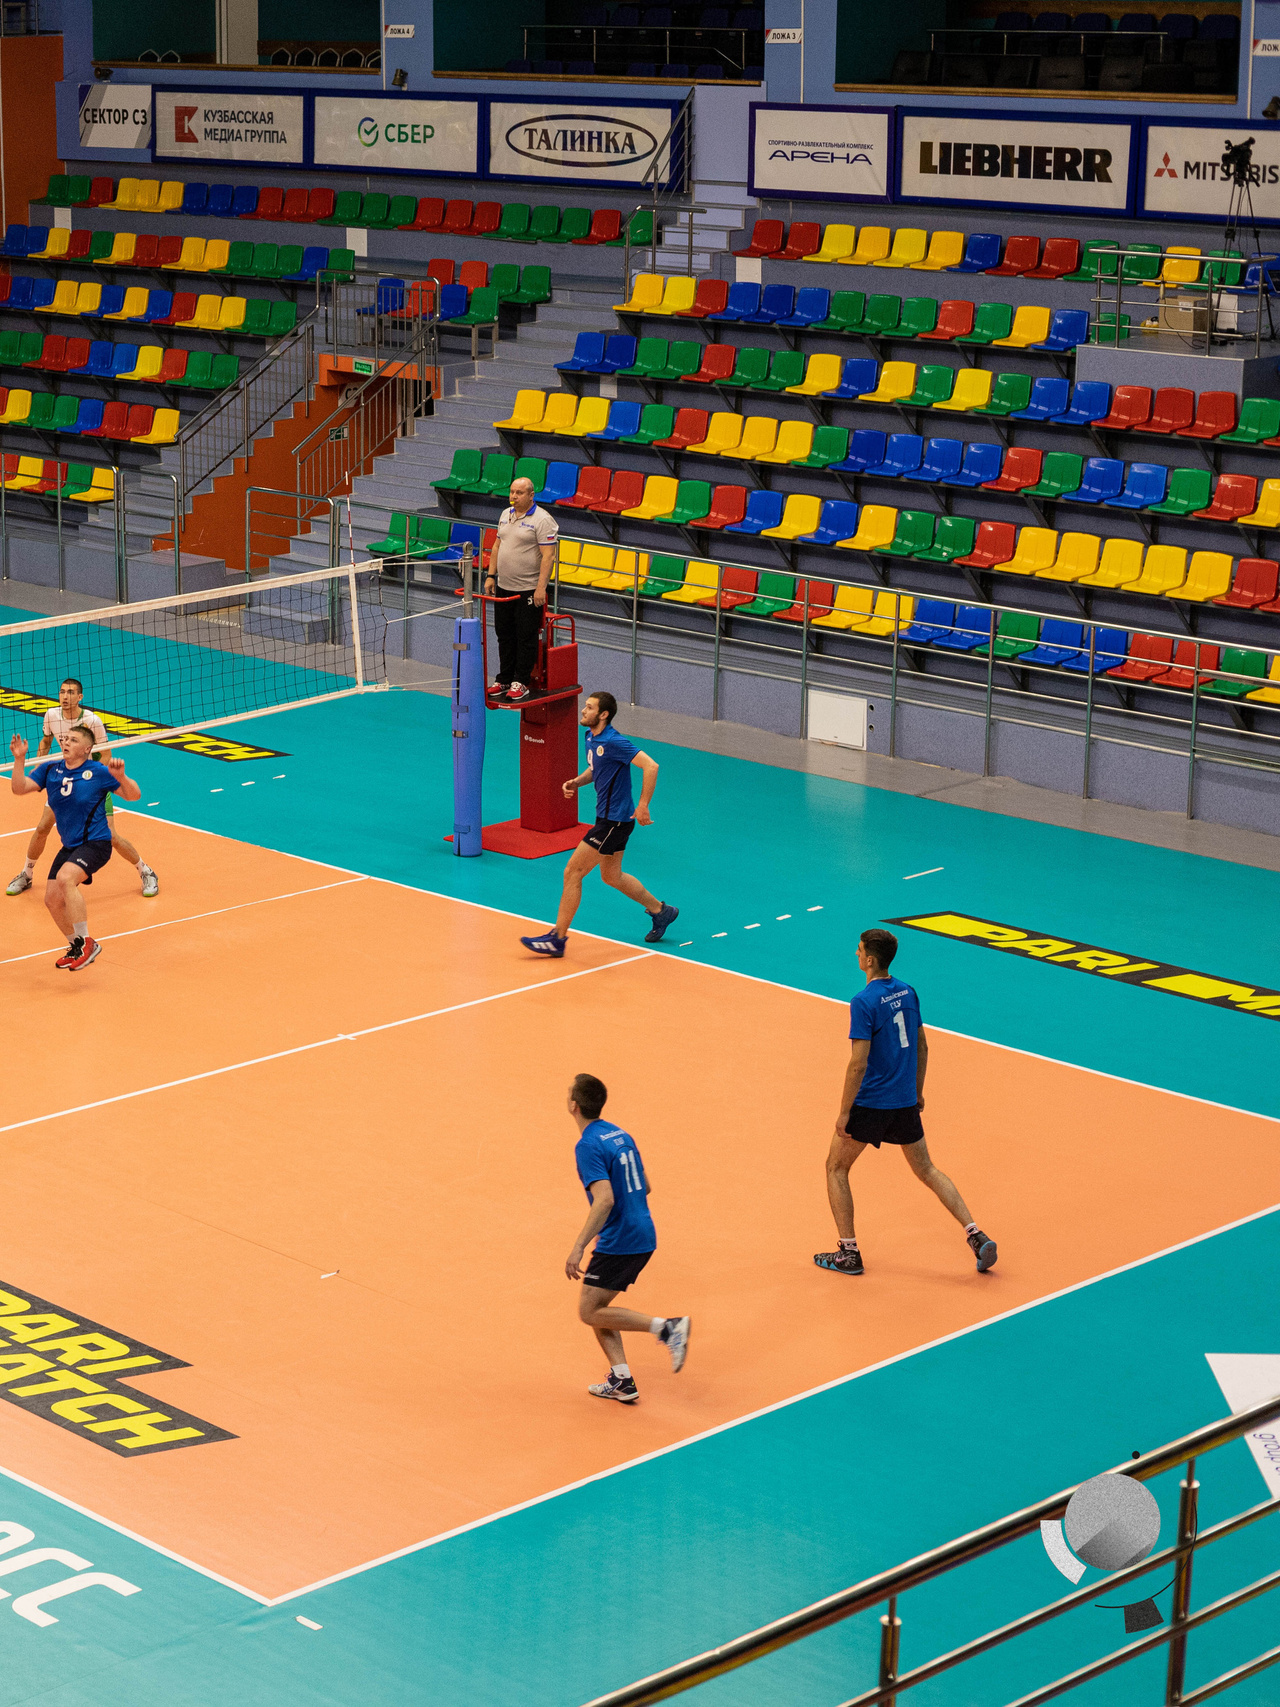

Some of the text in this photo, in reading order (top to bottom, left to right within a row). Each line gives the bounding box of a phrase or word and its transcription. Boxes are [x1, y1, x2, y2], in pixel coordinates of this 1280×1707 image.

[84, 108, 128, 125] СЕКТОР
[204, 109, 274, 125] КУЗБАССКАЯ
[204, 128, 287, 144] МЕДИА ГРУППА
[385, 123, 435, 144] СБЕР
[524, 128, 637, 155] ТАЛИНКА
[768, 140, 845, 149] СПОРТИВНО-РАЗВЛЕКАТЕЛЬНЫЙ
[769, 150, 872, 166] АРЕНА
[919, 141, 1113, 183] LIEBHERR
[1184, 161, 1279, 183] MITSBIS
[60, 777, 74, 797] 5
[902, 914, 1160, 975] PARI
[893, 1010, 909, 1048] 1
[619, 1149, 642, 1193] 11
